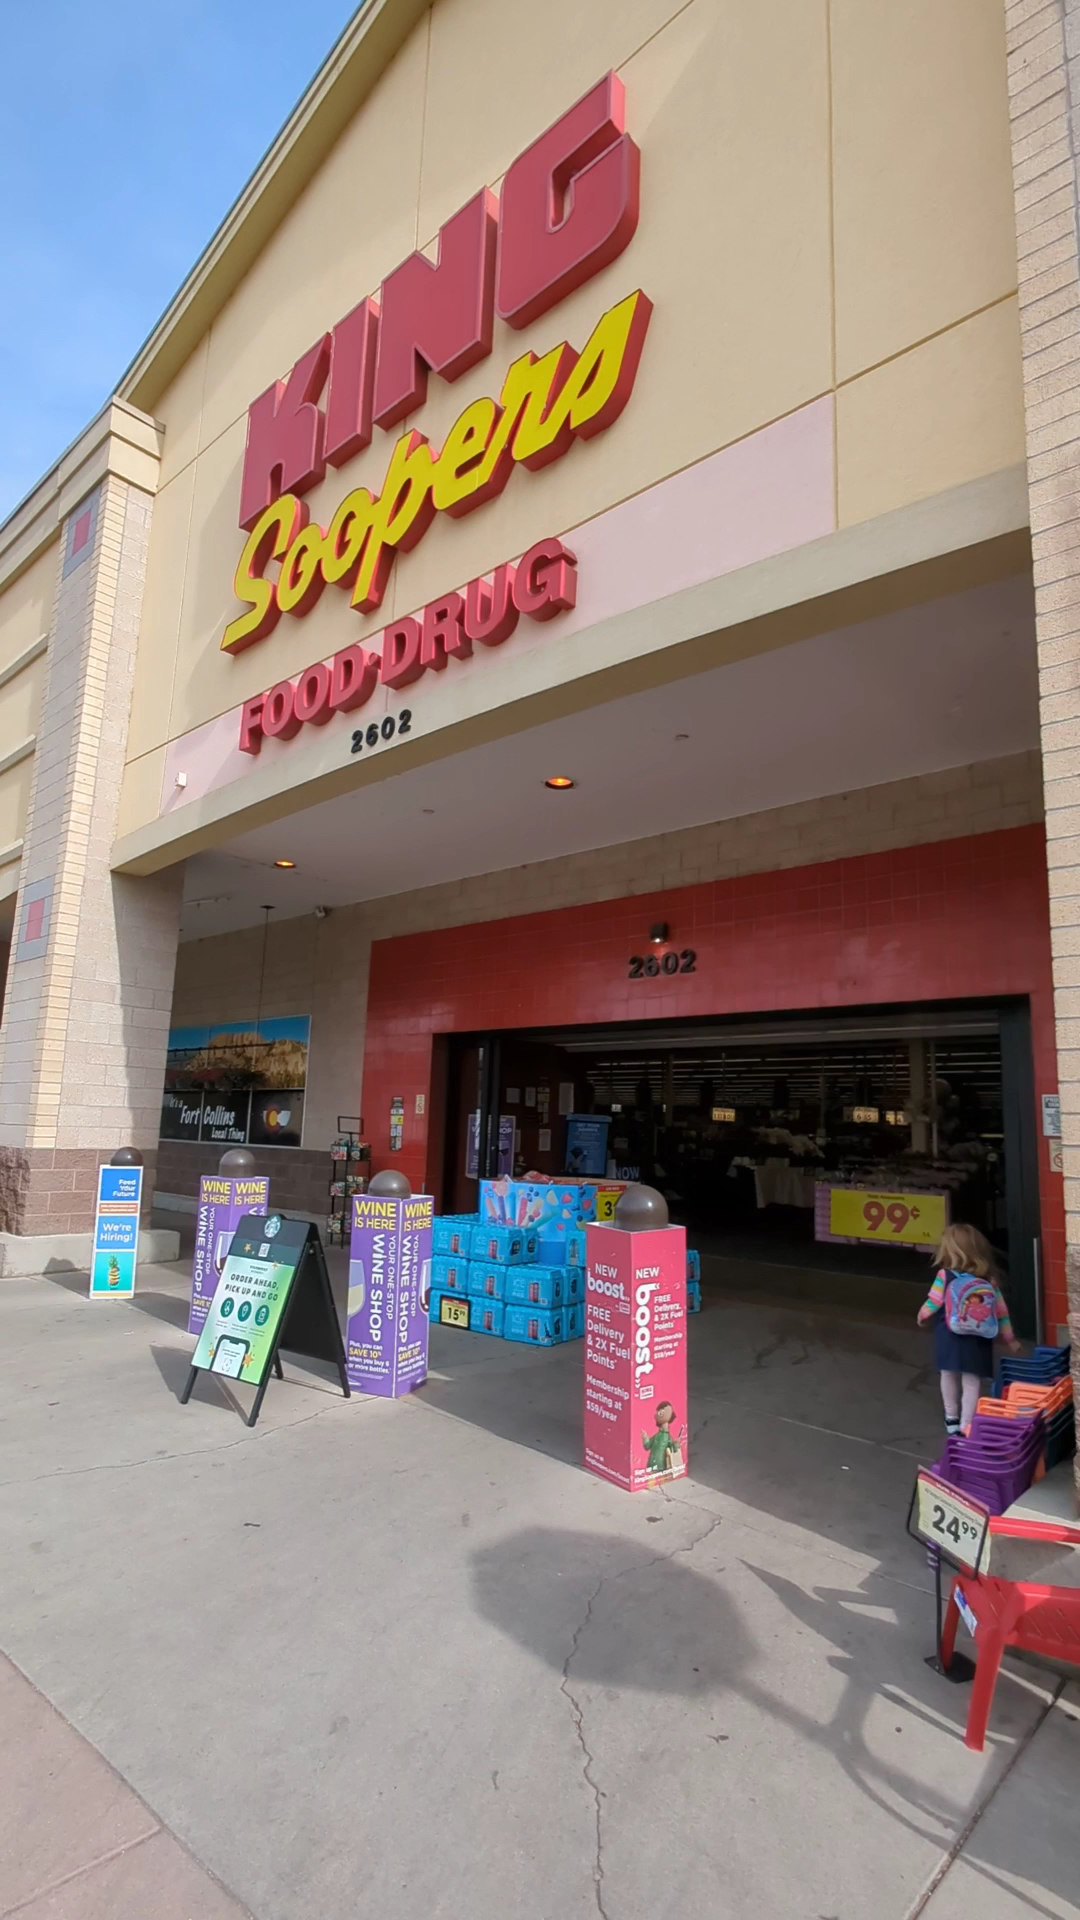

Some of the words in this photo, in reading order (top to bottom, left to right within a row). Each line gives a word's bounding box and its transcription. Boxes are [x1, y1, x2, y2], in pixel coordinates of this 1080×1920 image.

[239, 68, 640, 530] KING
[219, 289, 654, 655] Soopers
[351, 709, 412, 753] 2602
[628, 948, 697, 978] 2602
[180, 1105, 201, 1124] Fort
[203, 1105, 236, 1125] Collins
[211, 1127, 228, 1139] Local
[228, 1127, 245, 1142] Thing
[615, 1166, 640, 1179] NOW
[202, 1180, 231, 1194] WINE
[236, 1181, 266, 1194] WINE
[202, 1194, 209, 1203] IS
[210, 1195, 230, 1205] HERE
[234, 1196, 242, 1205] IS
[244, 1194, 265, 1204] HERE
[355, 1200, 397, 1218] WINE
[405, 1201, 433, 1218] WINE
[102, 1223, 132, 1232] We're
[196, 1206, 208, 1246] WINE
[208, 1206, 216, 1231] YOUR
[354, 1217, 364, 1228] IS
[366, 1218, 396, 1230] HERE
[404, 1220, 412, 1232] IS
[412, 1217, 432, 1230] HERE
[100, 1232, 133, 1243] Hiring!
[388, 1235, 396, 1264] YOUR
[412, 1234, 420, 1262] YOUR
[372, 1234, 388, 1285] WINE
[400, 1235, 412, 1288] WINE
[194, 1250, 204, 1292] SHOP
[595, 1263, 618, 1278] NEW
[636, 1267, 660, 1280] NEW
[230, 1274, 252, 1284] ORDER
[254, 1278, 279, 1290] AHEAD,
[410, 1265, 418, 1317] ONE-STOP
[587, 1269, 625, 1300] boost
[224, 1284, 240, 1292] PICK
[241, 1287, 251, 1295] UP
[252, 1290, 266, 1298] AND
[268, 1293, 278, 1301] GO
[386, 1266, 395, 1320] ONE-STOP
[654, 1294, 672, 1304] FREE
[369, 1289, 383, 1342] SHOP
[398, 1292, 410, 1343] SHOP
[588, 1304, 611, 1322] FREE
[660, 1312, 669, 1320] 2X
[670, 1310, 684, 1319] Fuel
[587, 1319, 624, 1344] Delivery
[636, 1283, 660, 1378] boost
[654, 1332, 683, 1343] Membership
[349, 1347, 369, 1357] SAVE
[587, 1334, 593, 1346] &
[595, 1337, 608, 1351] 2X
[610, 1343, 630, 1360] Fuel
[654, 1342, 673, 1352] starting
[348, 1356, 362, 1364] when
[374, 1359, 384, 1368] buy
[398, 1351, 412, 1362] SAVE
[586, 1374, 630, 1400] Membership
[586, 1389, 612, 1408] starting
[614, 1401, 622, 1410] at
[586, 1400, 617, 1422] $59/year
